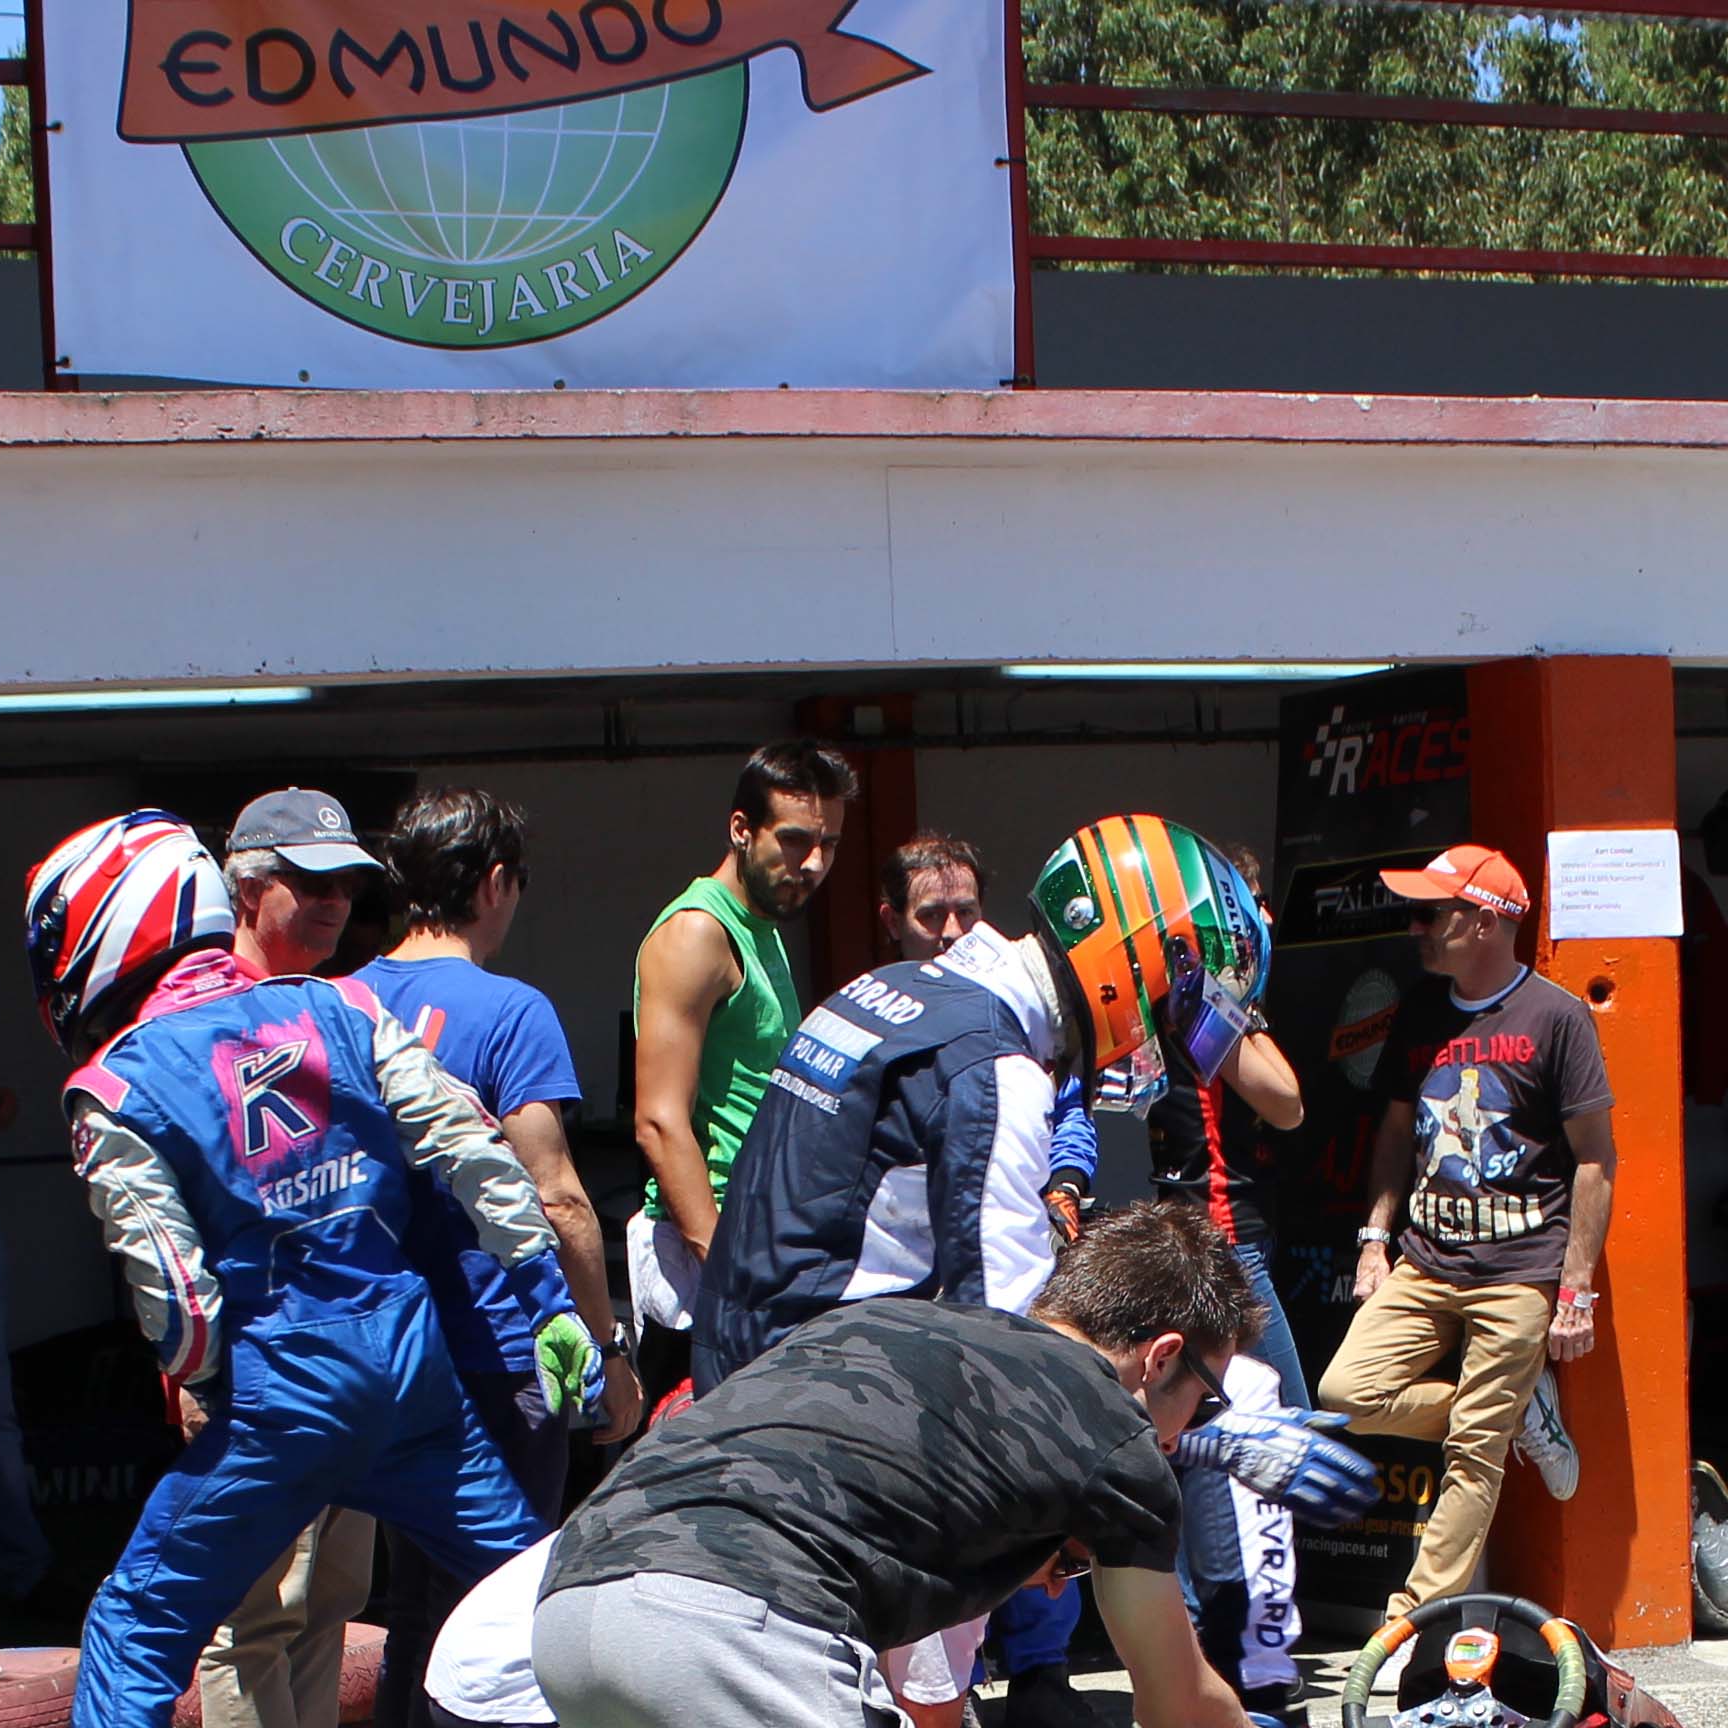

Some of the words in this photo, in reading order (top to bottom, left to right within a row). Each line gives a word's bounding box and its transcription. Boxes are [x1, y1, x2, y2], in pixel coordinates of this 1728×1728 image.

[159, 0, 722, 106] EDMUNDO
[278, 215, 654, 336] CERVEJARIA
[1464, 883, 1523, 915] BREITLING
[839, 973, 925, 1025] EVRARD
[233, 1040, 319, 1158] K
[790, 1036, 846, 1080] POLMAR
[257, 1150, 368, 1217] KOSMIC
[1256, 1498, 1289, 1649] EVRARD
